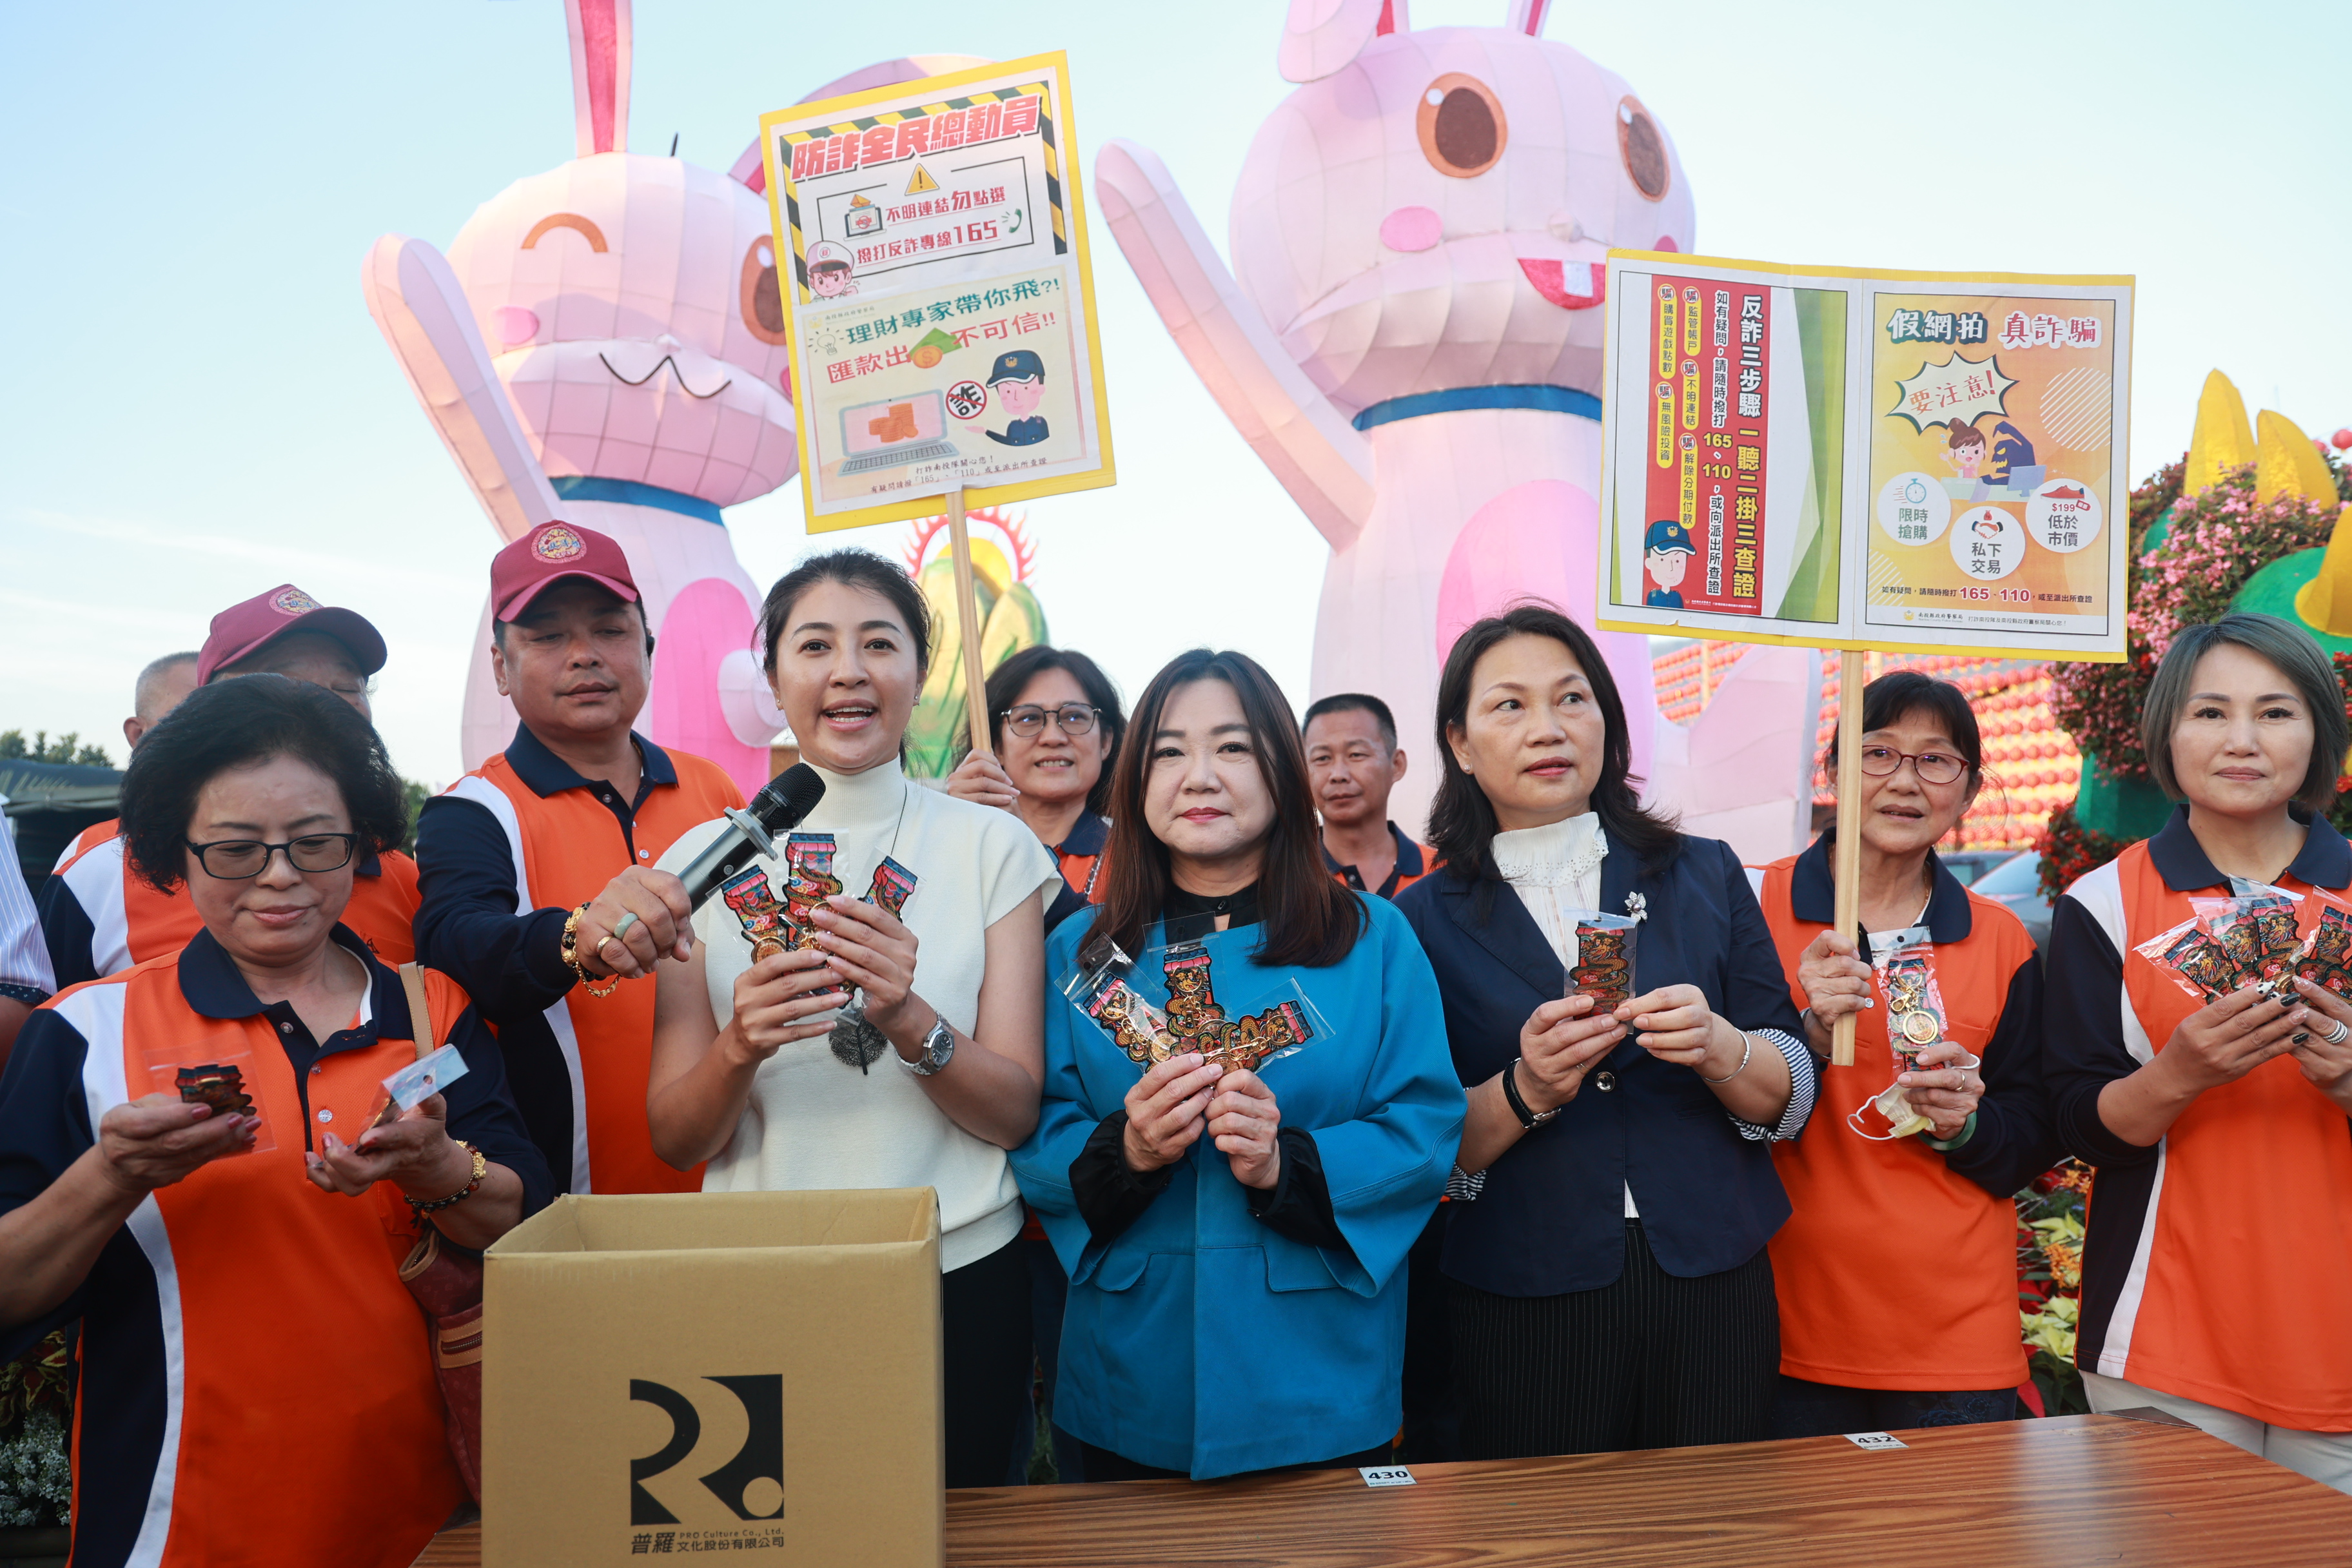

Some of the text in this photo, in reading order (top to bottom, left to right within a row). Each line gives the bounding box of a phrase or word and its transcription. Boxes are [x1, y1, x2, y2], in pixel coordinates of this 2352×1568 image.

[790, 93, 1041, 182] 防詐全民總動員
[886, 186, 1006, 222] 不明連結勿點選
[858, 220, 998, 264] 撥打反詐專線165
[847, 279, 1059, 346] 理財專家帶你飛?!
[1887, 309, 2097, 343] 假網拍 真詐騙
[1739, 295, 1763, 417] 反詐三步驟
[1685, 380, 1696, 425] 不明連結
[1908, 369, 1995, 416] 要注意!
[1660, 402, 1671, 460] 無風險投資
[1683, 453, 1695, 524] 解除分期付款
[1898, 507, 1928, 524] 限時
[2048, 514, 2078, 529] 低於
[2052, 503, 2075, 512] $199
[1897, 524, 1928, 540] 搶購
[2048, 531, 2078, 546] 市價
[1971, 542, 2001, 558] 私下
[1971, 559, 2001, 574] 交易
[1368, 1471, 1408, 1480] 430
[631, 1532, 676, 1555] 普羅
[677, 1536, 784, 1552] 文化股份有限公司
